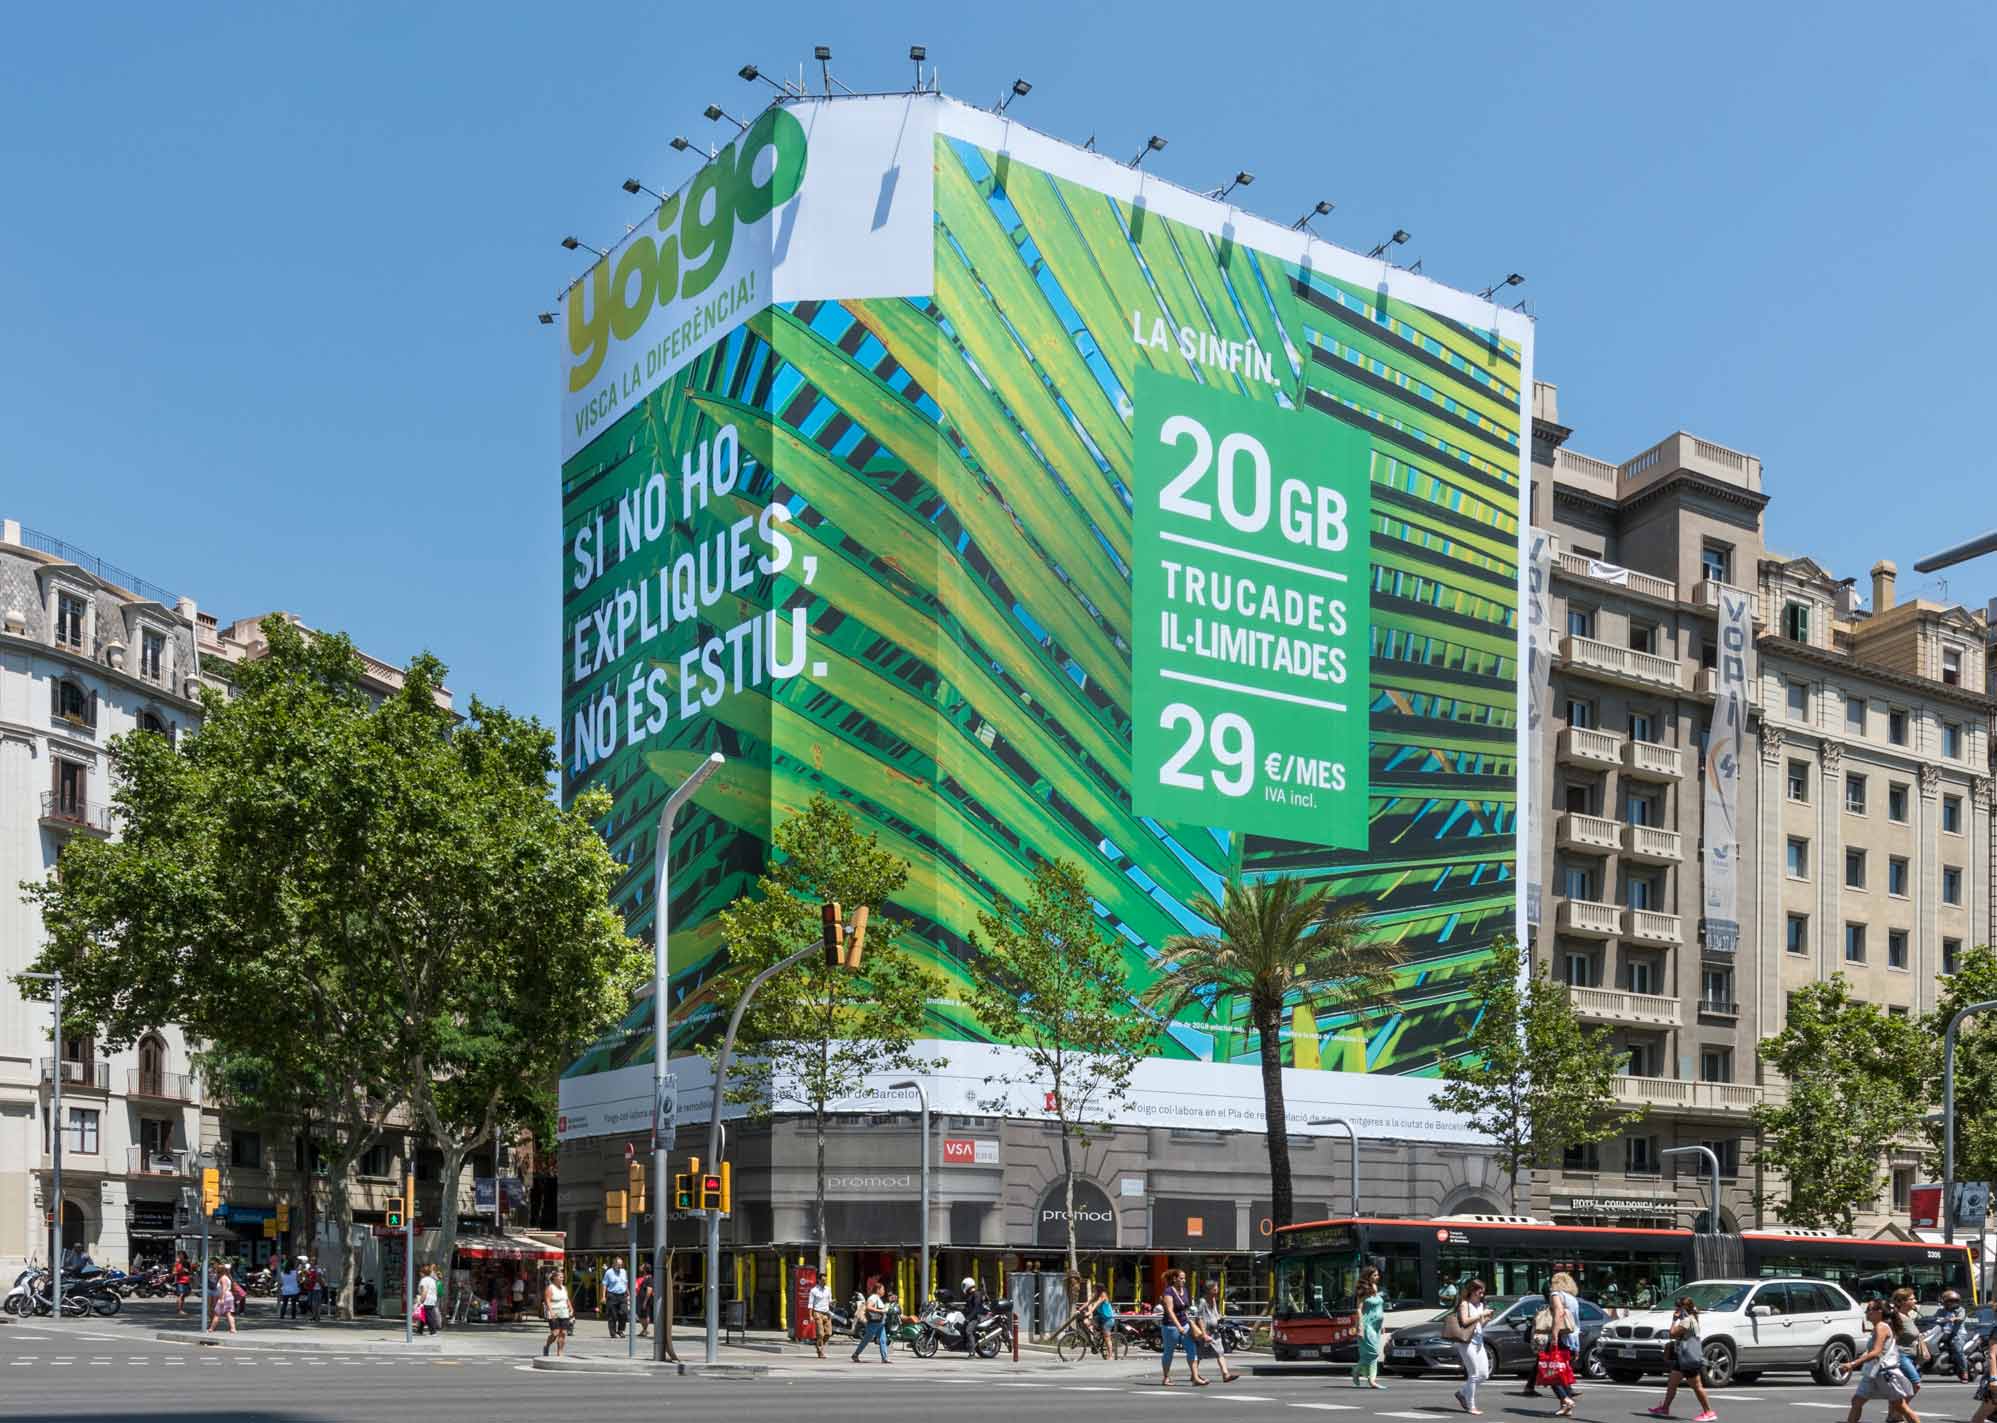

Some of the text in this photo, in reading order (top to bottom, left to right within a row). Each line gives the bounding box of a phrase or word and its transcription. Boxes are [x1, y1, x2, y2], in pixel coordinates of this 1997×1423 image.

[568, 107, 807, 393] yoigo
[575, 270, 756, 438] VISCA LA DIFERÈNCIA!
[1133, 310, 1169, 352] LA
[574, 424, 738, 590] SI NO HO
[1159, 415, 1348, 552] 20 GB
[574, 502, 818, 682] EXPLIQUES,
[1160, 559, 1347, 637] TRUCADES
[574, 607, 828, 771] NO ÉS ESTIU.
[1159, 702, 1346, 797] 29 €/MES
[1265, 786, 1318, 809] IVA incl.
[872, 1088, 926, 1099] Barcelon
[827, 1175, 910, 1190] promod
[1572, 1199, 1599, 1209] HOTEL
